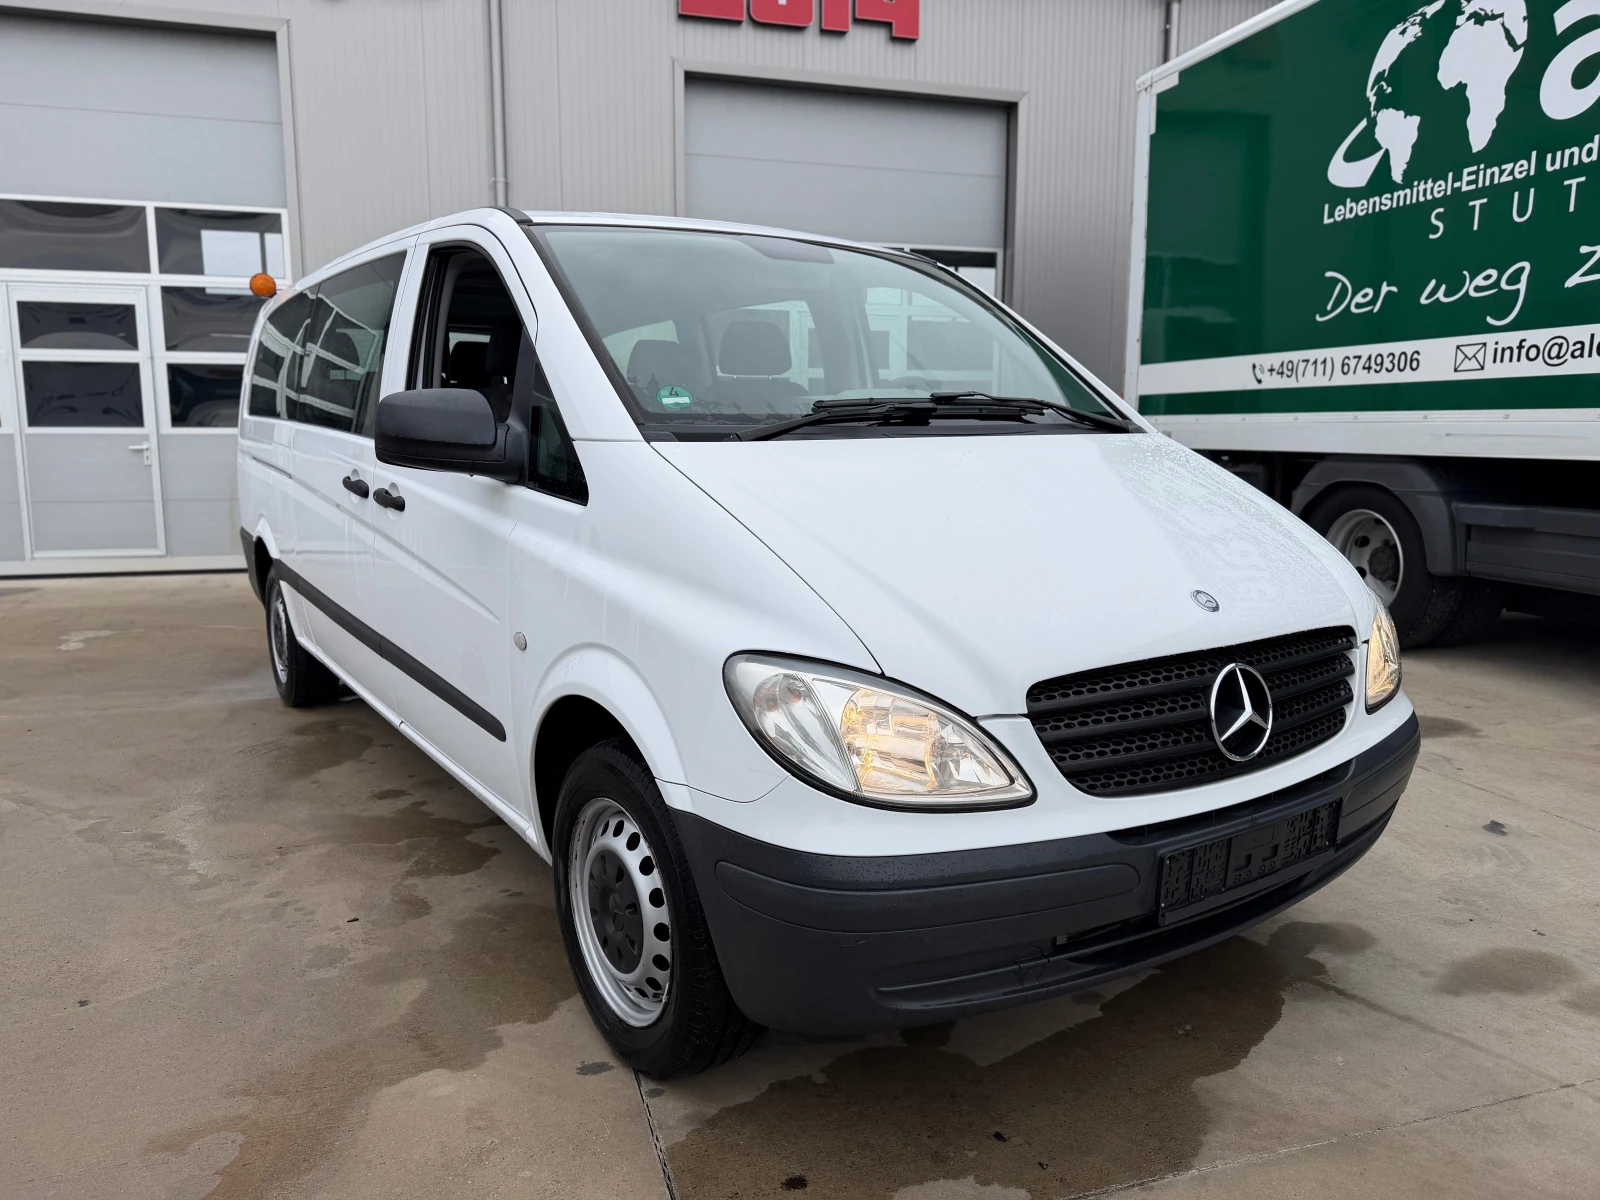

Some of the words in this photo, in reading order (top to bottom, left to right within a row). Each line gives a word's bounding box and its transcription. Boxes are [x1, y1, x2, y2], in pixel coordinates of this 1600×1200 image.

[1323, 151, 1536, 225] Lebensmittel-Einzel
[1545, 134, 1600, 172] und
[1315, 271, 1398, 322] Der
[1420, 261, 1531, 326] weg
[1267, 356, 1334, 383] +49(711)
[1341, 350, 1421, 376] 6749306
[669, 386, 680, 397] 4
